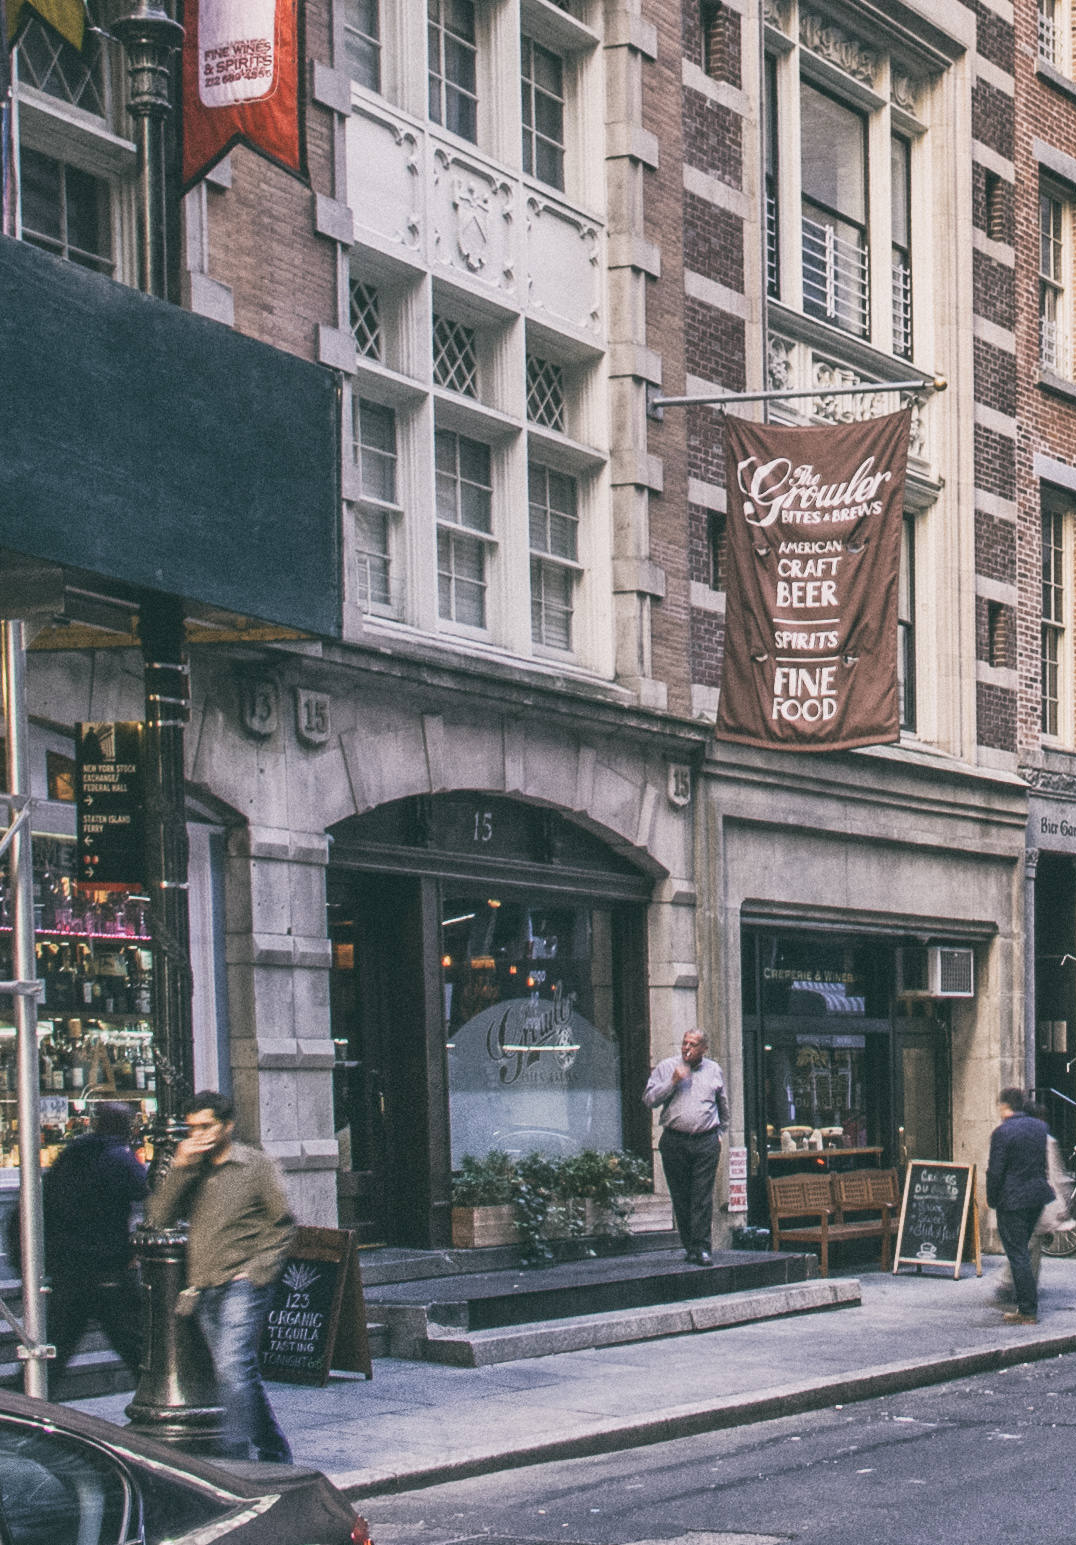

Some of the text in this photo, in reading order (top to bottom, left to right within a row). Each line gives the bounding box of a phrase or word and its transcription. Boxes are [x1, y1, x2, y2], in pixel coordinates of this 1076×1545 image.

[204, 42, 271, 62] FINE WINES
[204, 55, 272, 76] & SPIRITS
[789, 465, 821, 487] The
[737, 457, 892, 527] Growler
[781, 508, 821, 524] BITES
[831, 501, 884, 524] BREWS
[778, 540, 842, 554] AMERICAN
[777, 557, 842, 577] CRAFT
[776, 580, 839, 608] BEER
[774, 630, 839, 650] SPIRITS
[773, 666, 838, 697] FINE
[304, 699, 327, 734] 15
[771, 697, 838, 722] FOOD
[98, 764, 115, 773] YORK
[116, 764, 137, 773] STOCK
[83, 783, 127, 792] FEDERAL HALL
[674, 770, 689, 798] 15
[83, 815, 131, 824] STATEN ISLAND
[83, 824, 103, 833] FERRY
[473, 811, 493, 842] 15
[1040, 817, 1059, 835] Bier
[286, 1293, 310, 1308] 123
[268, 1311, 323, 1328] ORGANIC
[268, 1326, 319, 1341] TEQUILA
[270, 1340, 314, 1352] TASTING
